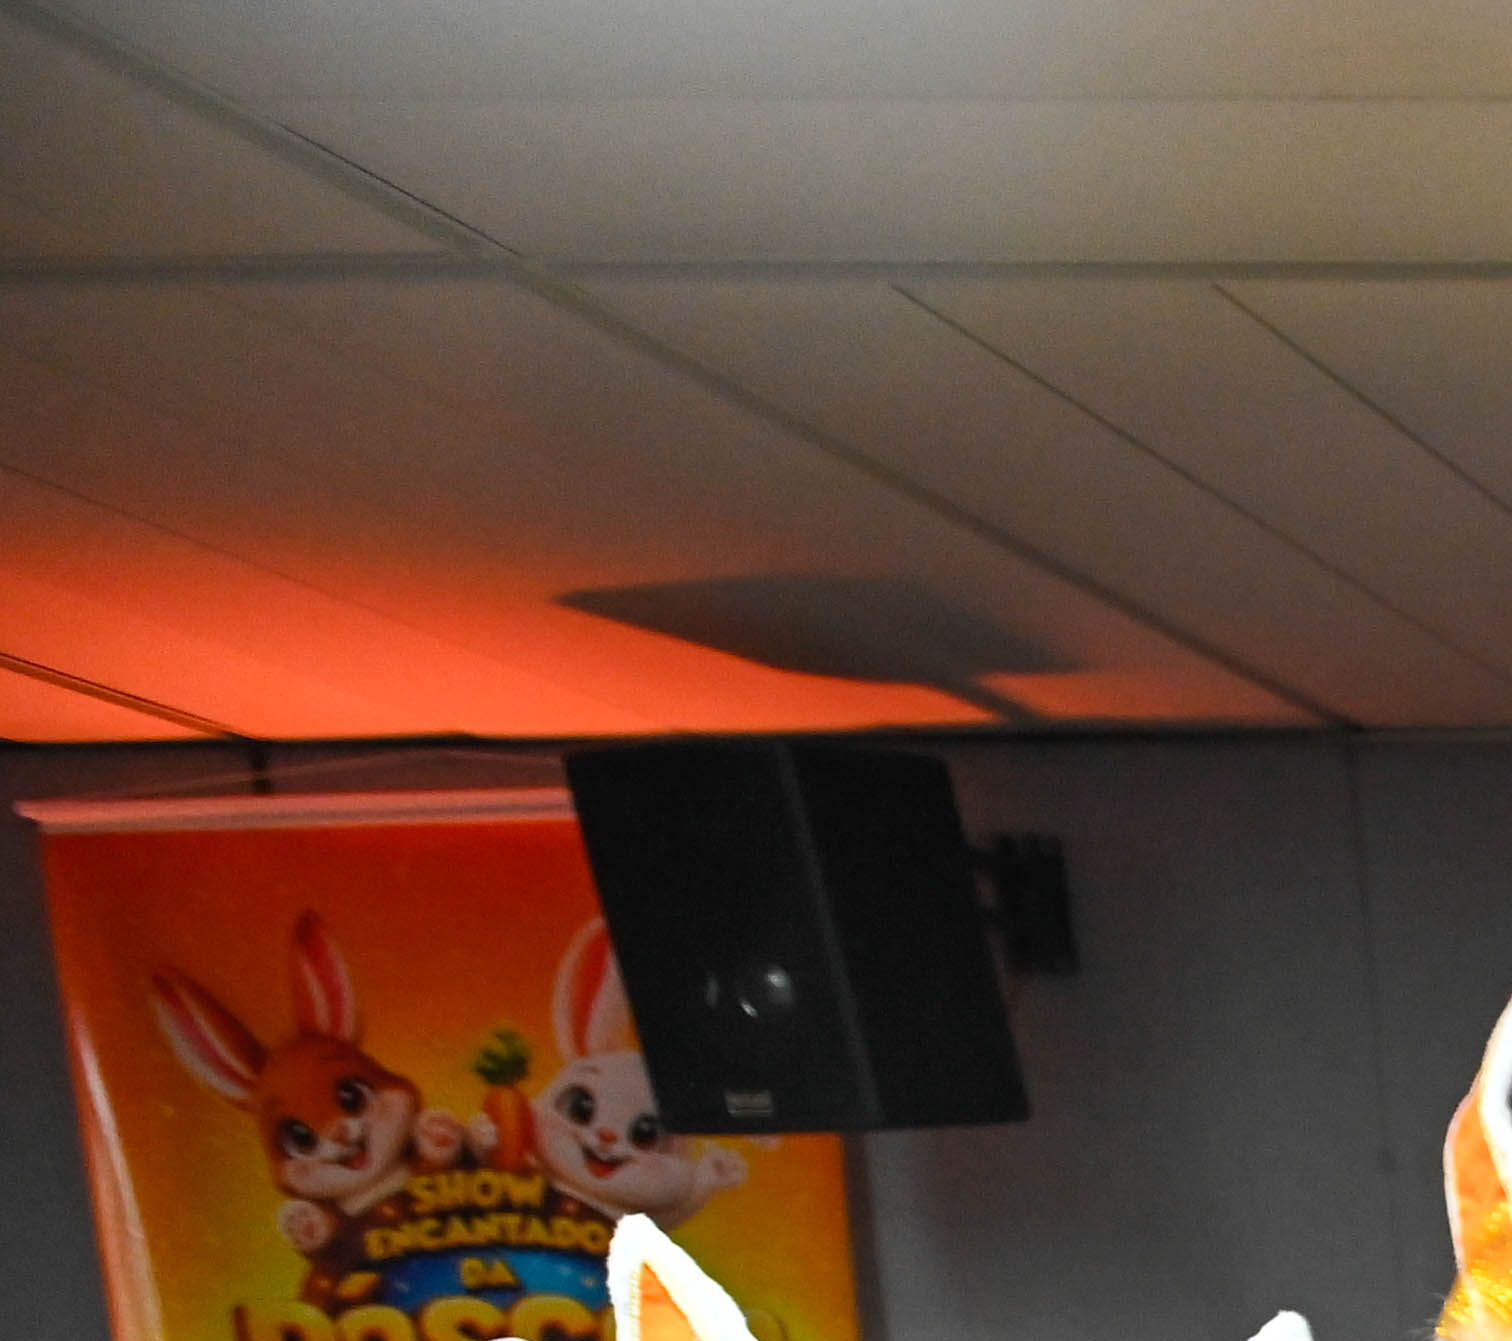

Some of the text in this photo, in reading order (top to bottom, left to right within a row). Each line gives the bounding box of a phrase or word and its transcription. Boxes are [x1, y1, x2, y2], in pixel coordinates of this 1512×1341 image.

[408, 1170, 546, 1212] SHOW
[364, 1212, 611, 1259] ENCANTADO
[459, 1257, 519, 1288] DA
